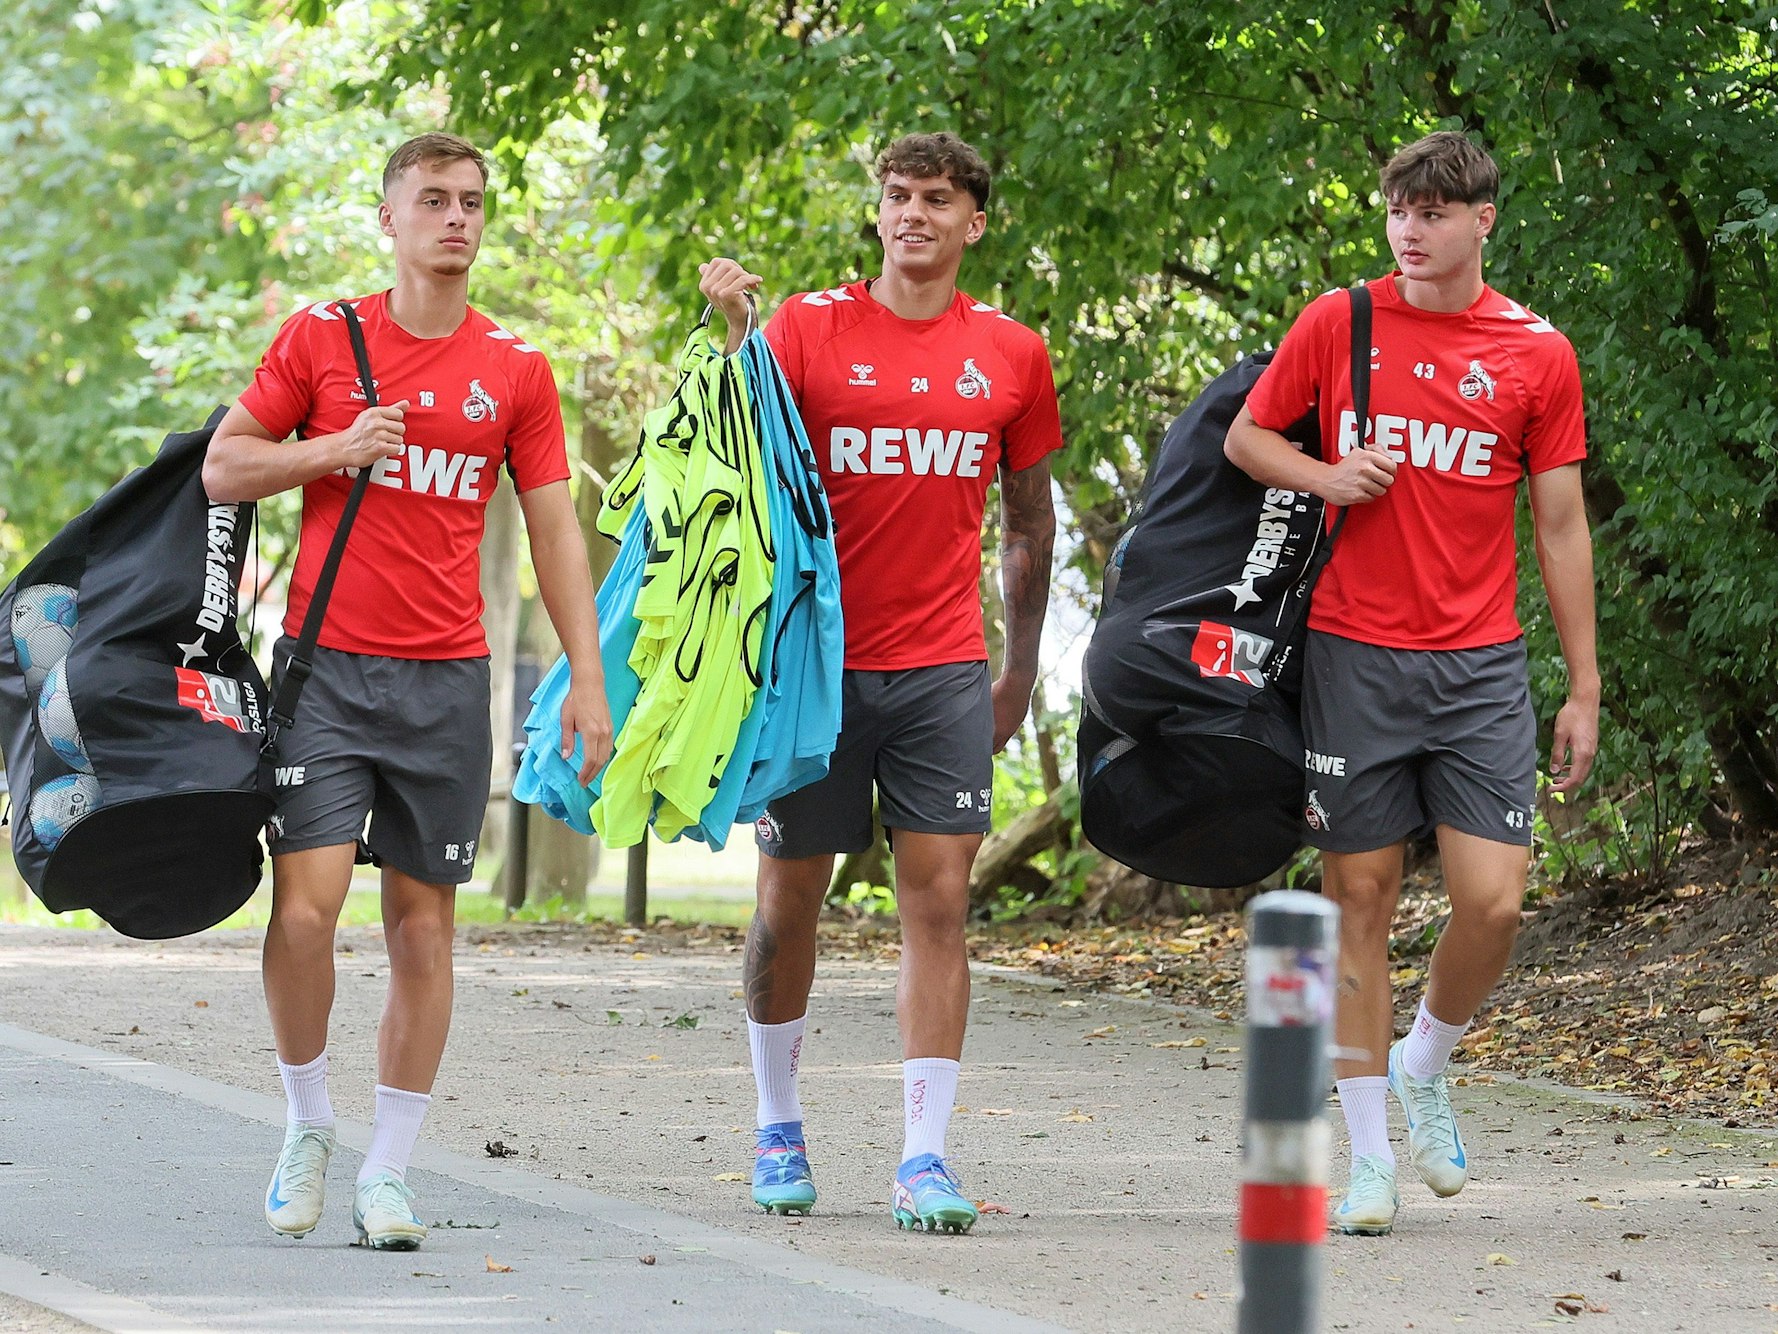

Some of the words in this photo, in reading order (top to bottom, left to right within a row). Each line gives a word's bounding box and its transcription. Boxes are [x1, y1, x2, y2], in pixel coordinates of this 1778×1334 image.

[1413, 362, 1435, 379] 43
[911, 377, 929, 393] 24
[418, 390, 435, 407] 16
[830, 426, 989, 478] REWE
[333, 442, 487, 501] EWE
[196, 499, 240, 634] DERBYSTA
[275, 766, 306, 787] WE
[955, 791, 973, 809] 24
[1505, 810, 1524, 829] 43
[445, 843, 460, 861] 16
